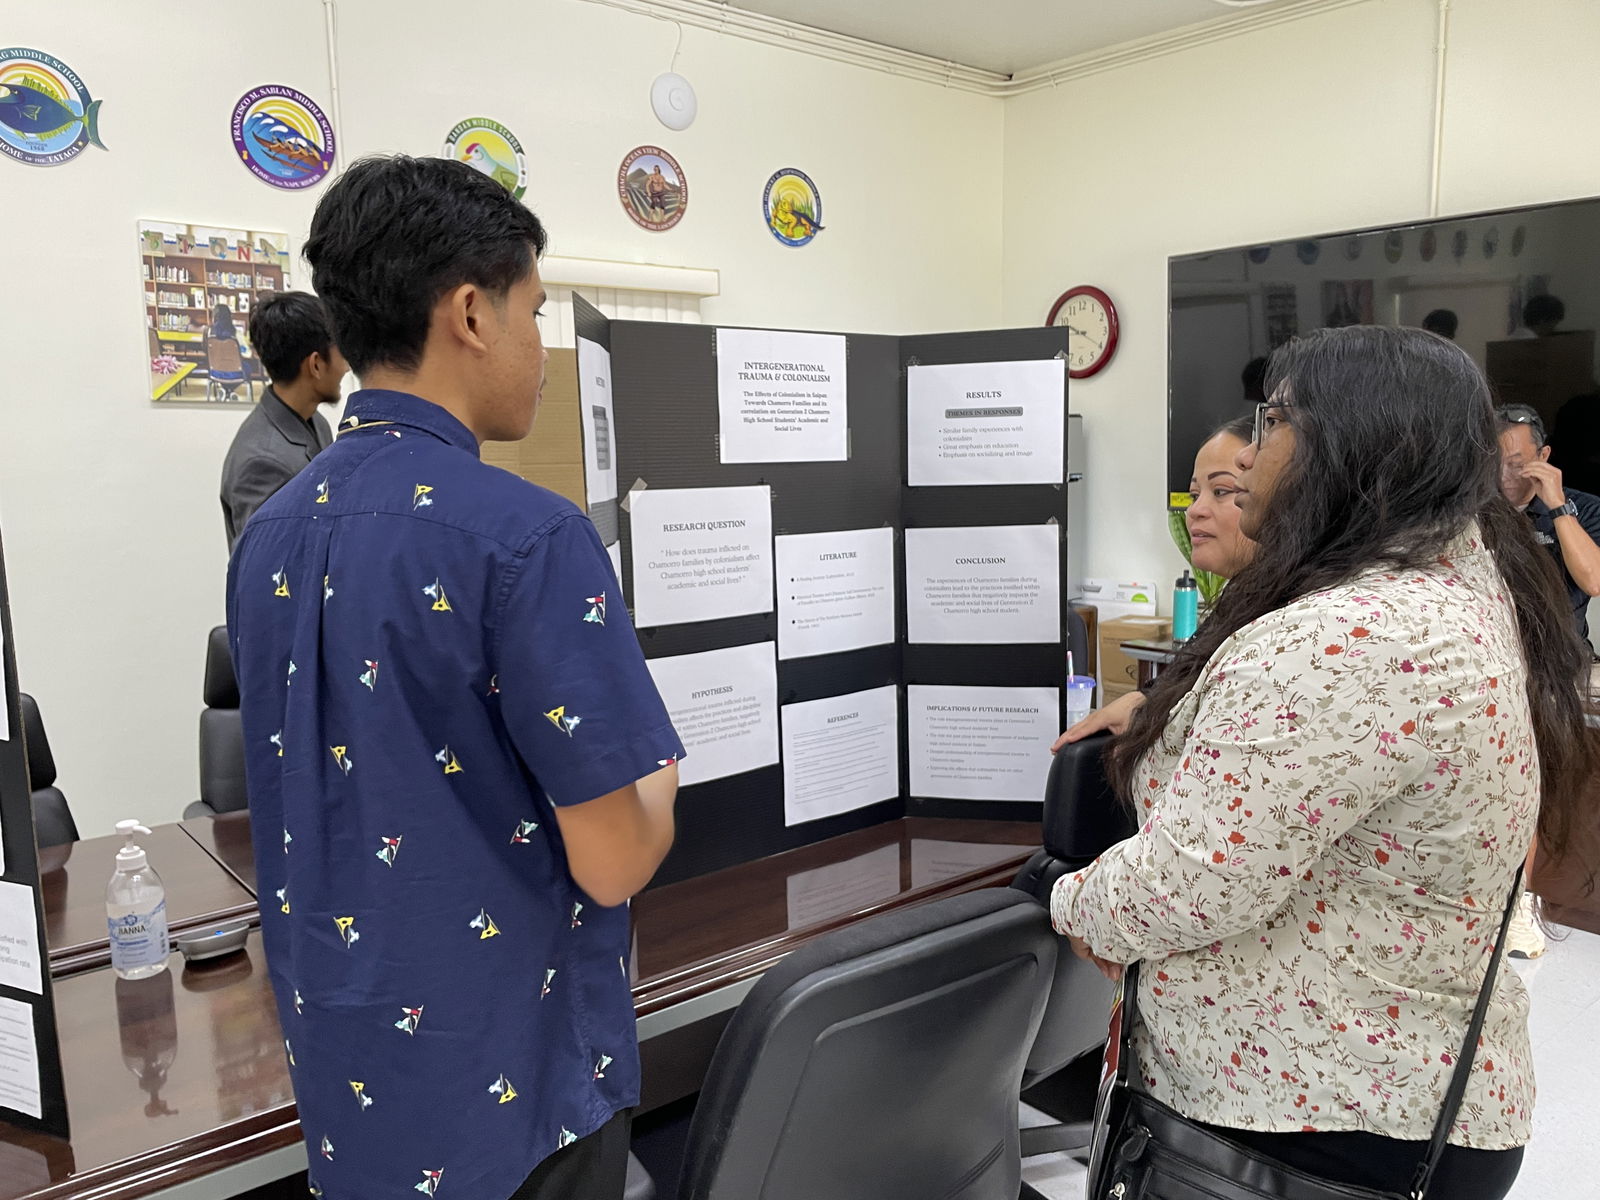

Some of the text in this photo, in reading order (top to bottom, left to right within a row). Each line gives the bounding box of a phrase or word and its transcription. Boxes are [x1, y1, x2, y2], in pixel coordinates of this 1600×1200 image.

[10, 49, 85, 93] MIDDLE SCHOOL
[233, 87, 333, 154] FRANCISCO M. SABLAN MIDDLE SCHOOL
[472, 119, 497, 129] MIDDLE
[499, 127, 520, 152] SCHOOL
[47, 146, 80, 163] TATAGA
[625, 150, 642, 166] OCEAN
[1069, 306, 1076, 315] 11
[1079, 301, 1086, 310] 12
[1092, 304, 1094, 312] 1
[1100, 313, 1104, 321] 2
[1103, 326, 1107, 336] 3
[1079, 355, 1083, 365] 6
[1090, 351, 1094, 361] 5
[744, 362, 825, 372] INTERGENERATIONAL
[738, 372, 773, 381] TRAUMA
[783, 374, 830, 383] COLONIALISM
[966, 391, 1002, 399] RESULTS
[962, 427, 977, 435] family
[979, 426, 1010, 434] experiences
[959, 443, 982, 451] emphasis
[977, 451, 1003, 459] socializing
[663, 520, 746, 532] RESEARCH QUESTION
[698, 546, 717, 554] trauma
[719, 545, 741, 553] inflicted
[648, 559, 680, 568] Chamorro
[682, 558, 704, 566] families
[705, 557, 712, 566] by
[746, 553, 760, 561] affect
[820, 552, 856, 561] LITERATURE
[661, 570, 692, 579] Chamorro
[693, 569, 706, 578] high
[708, 567, 726, 575] school
[667, 580, 696, 589] academic
[698, 579, 709, 587] and
[710, 578, 725, 586] social
[692, 686, 733, 699] HYPOTHESIS
[827, 712, 859, 723] REFERENCES
